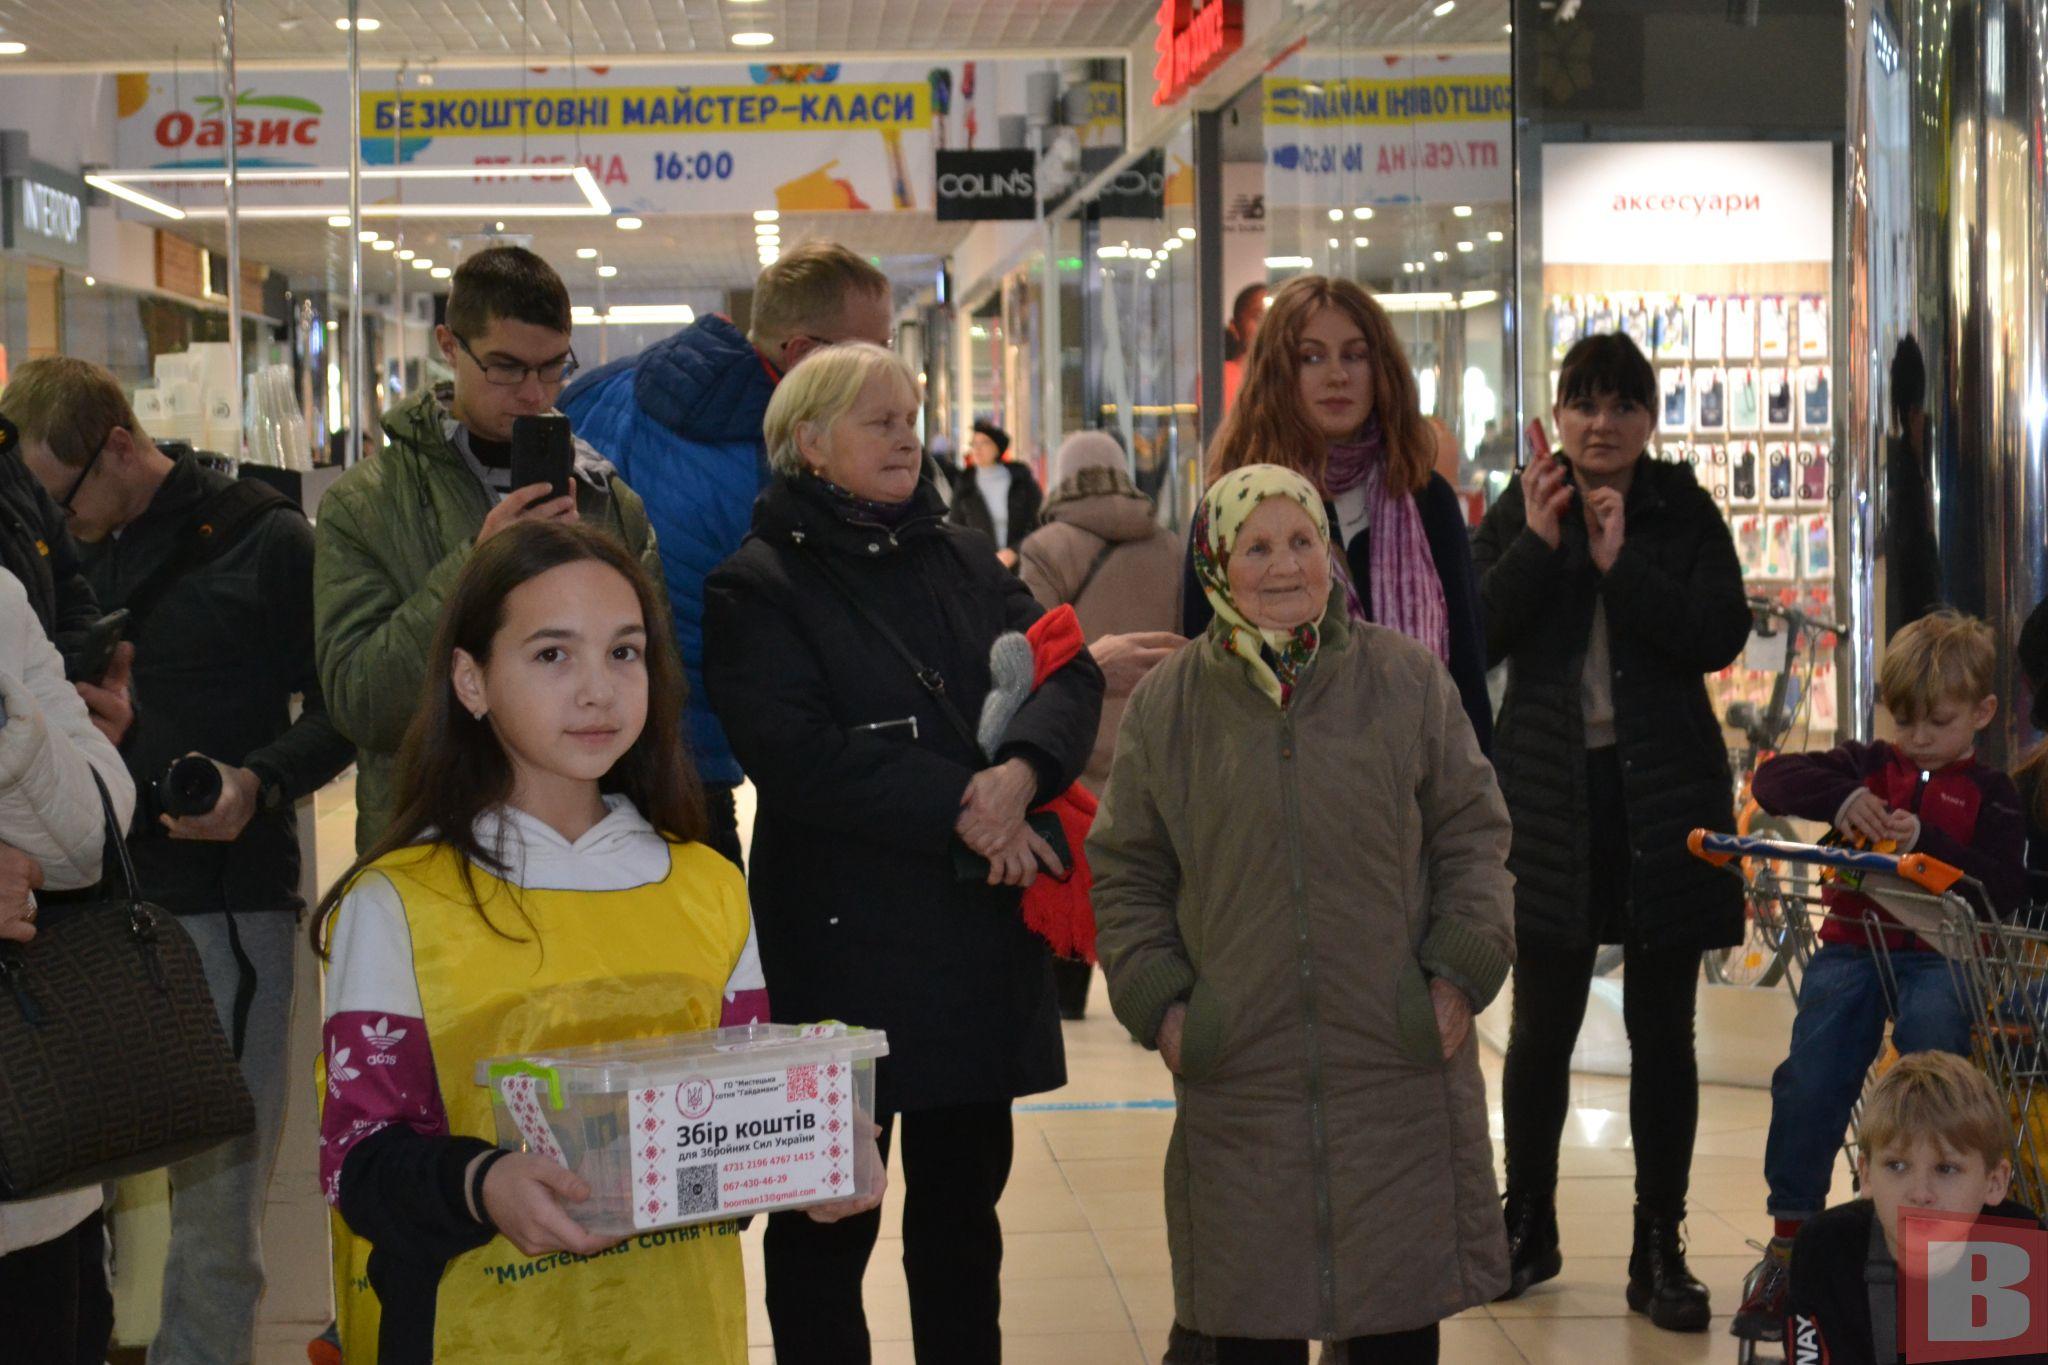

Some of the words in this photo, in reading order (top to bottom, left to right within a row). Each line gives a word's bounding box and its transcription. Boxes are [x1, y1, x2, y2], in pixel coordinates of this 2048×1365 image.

[375, 97, 609, 130] БЕЗКОШТОВНІ
[622, 86, 914, 126] МАЙСТЕР-КЛАСИ
[154, 110, 321, 148] Оазис
[655, 150, 734, 181] 16:00
[937, 168, 1034, 198] COLIN'S
[1612, 193, 1760, 216] аксесуари
[676, 1121, 728, 1148] Збір
[736, 1109, 816, 1140] коштів
[678, 1152, 698, 1162] для
[700, 1143, 752, 1159] Збройних
[753, 1139, 773, 1150] Сил
[775, 1132, 816, 1148] України
